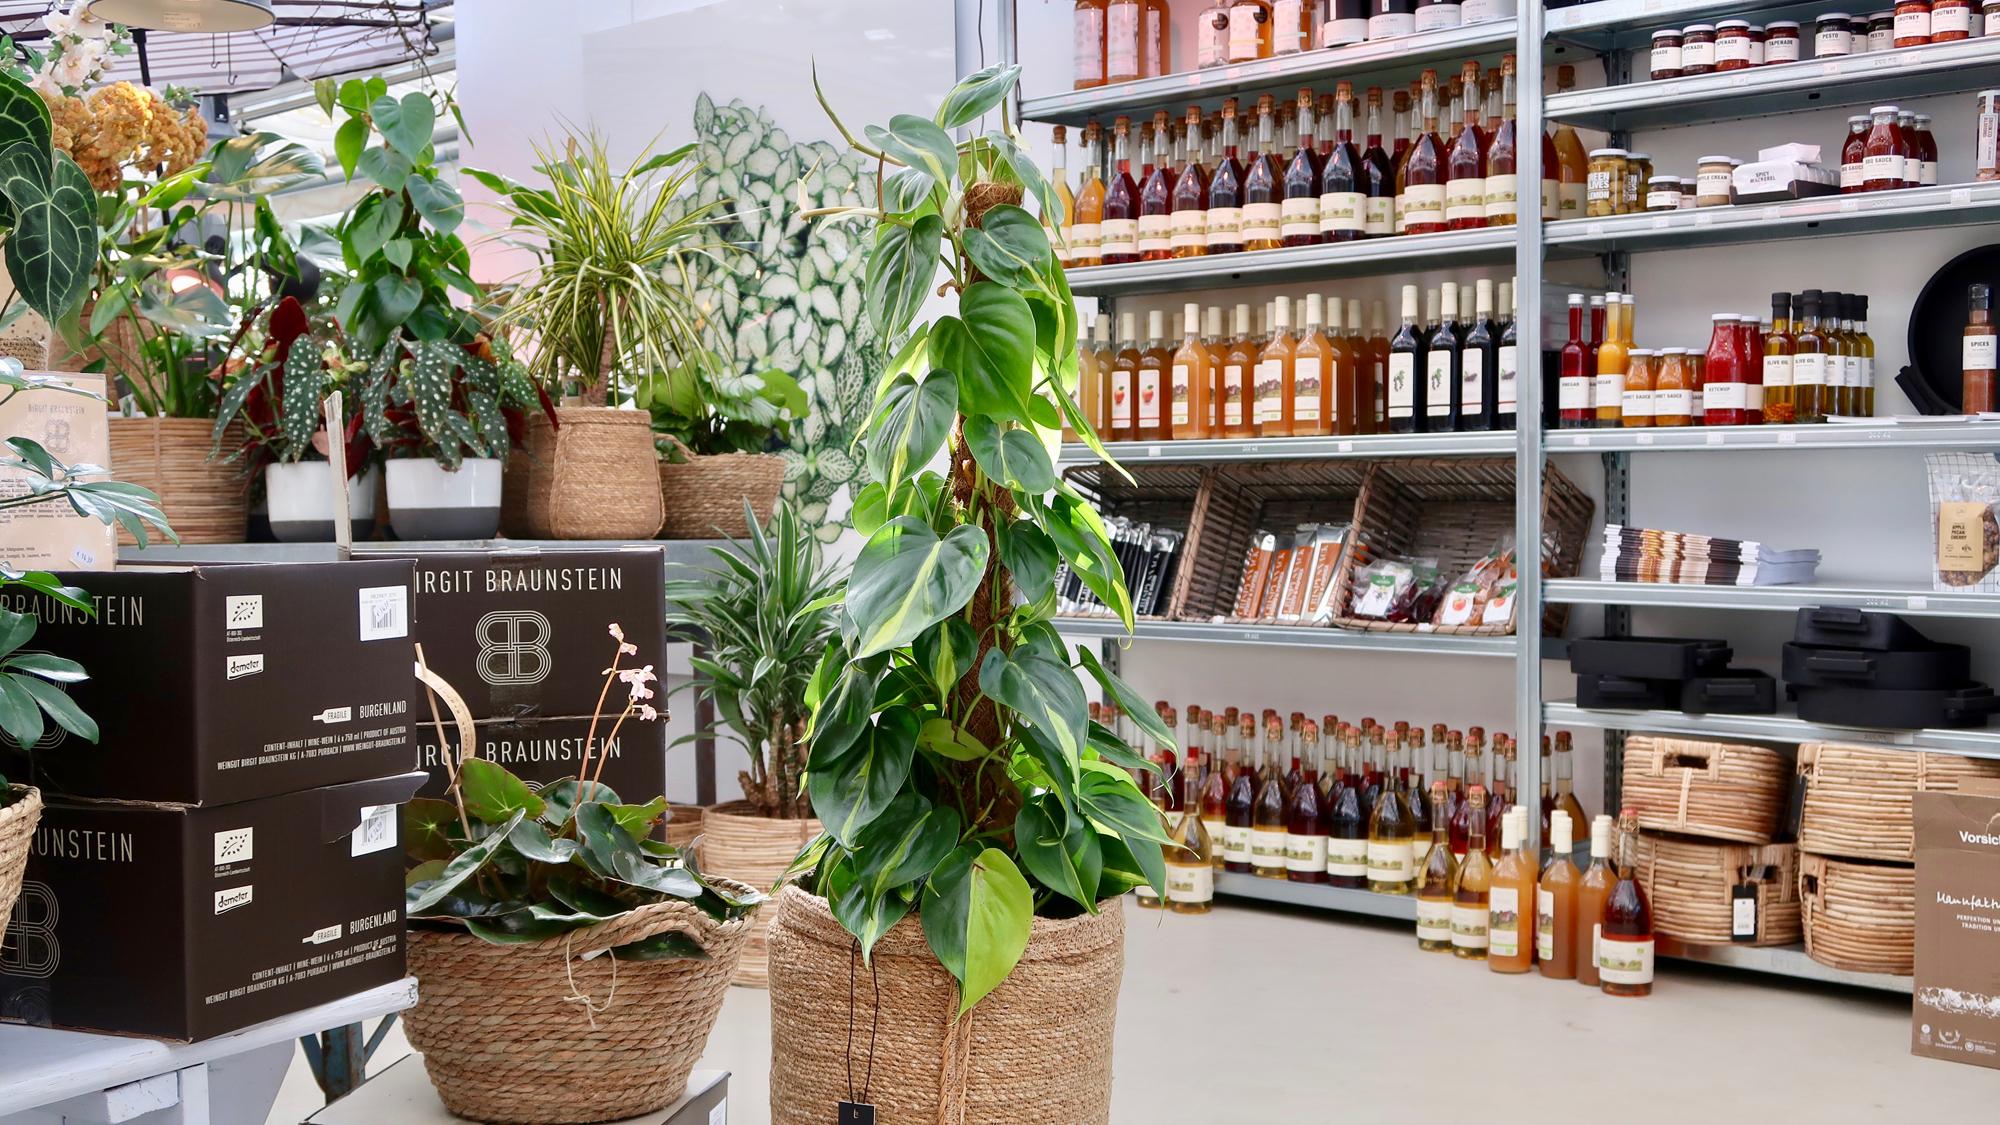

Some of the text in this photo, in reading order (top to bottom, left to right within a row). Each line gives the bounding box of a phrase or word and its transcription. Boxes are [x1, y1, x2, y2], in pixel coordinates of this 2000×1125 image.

[486, 568, 622, 592] BRAUNSTEIN
[230, 660, 259, 674] demeter
[327, 710, 347, 720] FRAGILE
[359, 700, 407, 719] BURGENLAND
[345, 733, 353, 741] 750
[364, 730, 383, 740] PRODUCT
[389, 726, 407, 735] AUSTRIA
[217, 760, 240, 770] WEINGUT
[241, 757, 257, 767] BIRGIT
[258, 754, 289, 765] BRAUNSTEIN
[290, 752, 296, 760] KG
[318, 747, 338, 757] PURBACH
[30, 827, 133, 862] UNSTEIN
[217, 891, 248, 908] demeter
[350, 909, 397, 935] BURGENLAND
[1956, 914, 1991, 924] PERFEKTION
[1961, 922, 1992, 931] TRADITION
[317, 928, 337, 940] FRAGILE
[252, 963, 292, 981] CONTENT-INHALT
[205, 991, 228, 1005] WEINGUT
[229, 987, 246, 999] BIRGIT
[247, 978, 277, 994] BRAUNSTEIN
[277, 975, 285, 985] KG
[306, 965, 328, 979] PURBACH
